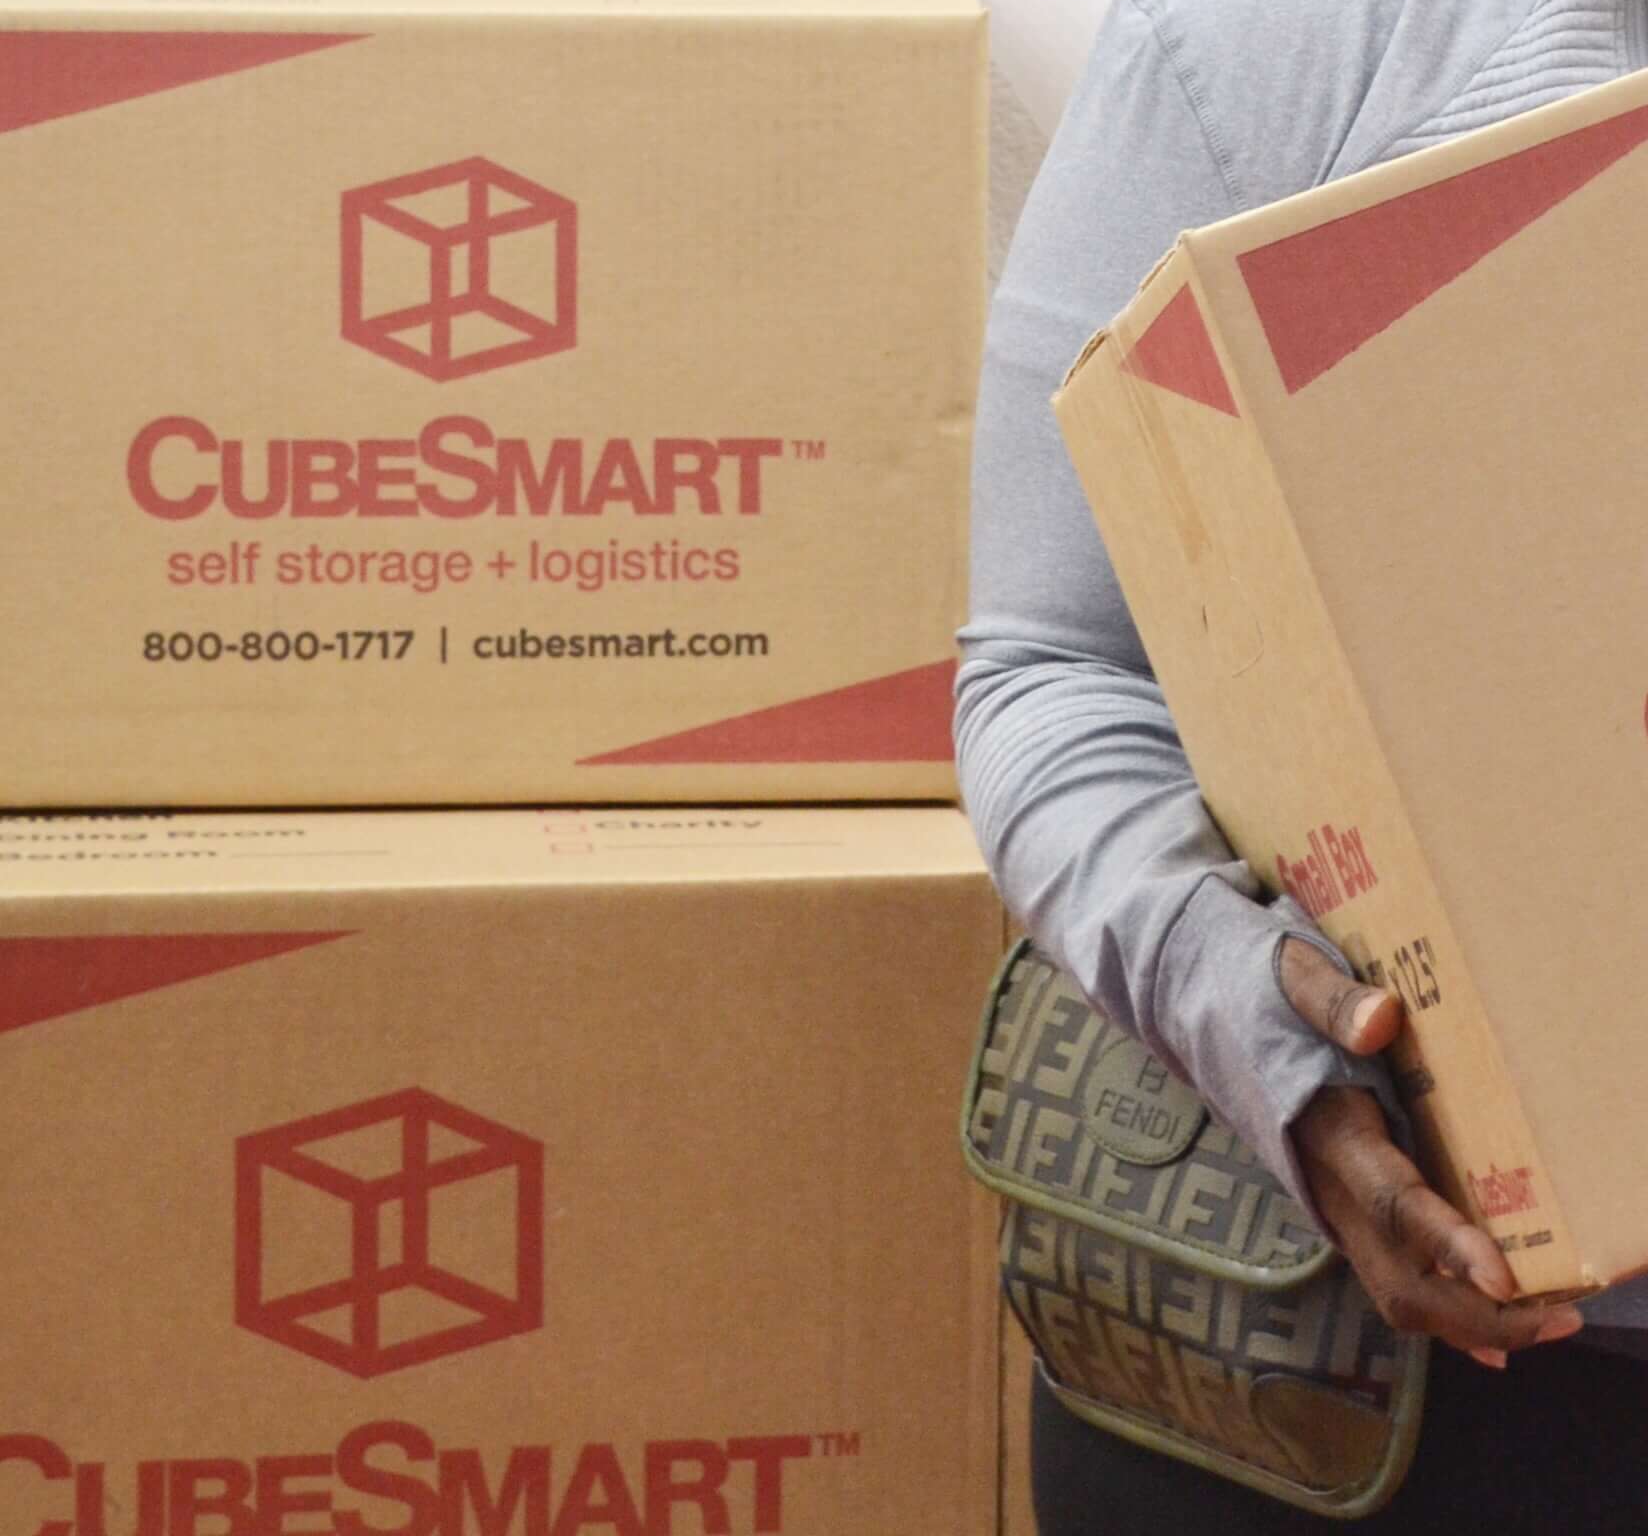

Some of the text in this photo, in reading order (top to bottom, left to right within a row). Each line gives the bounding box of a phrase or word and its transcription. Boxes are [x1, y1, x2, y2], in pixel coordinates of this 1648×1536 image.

[168, 543, 259, 586] self
[277, 545, 473, 594] storage
[529, 540, 741, 594] logistics
[143, 630, 415, 663] 800-800-1717
[473, 627, 770, 660] cubesmart.com
[1320, 823, 1379, 900] Box
[1094, 1087, 1183, 1145] FENDI
